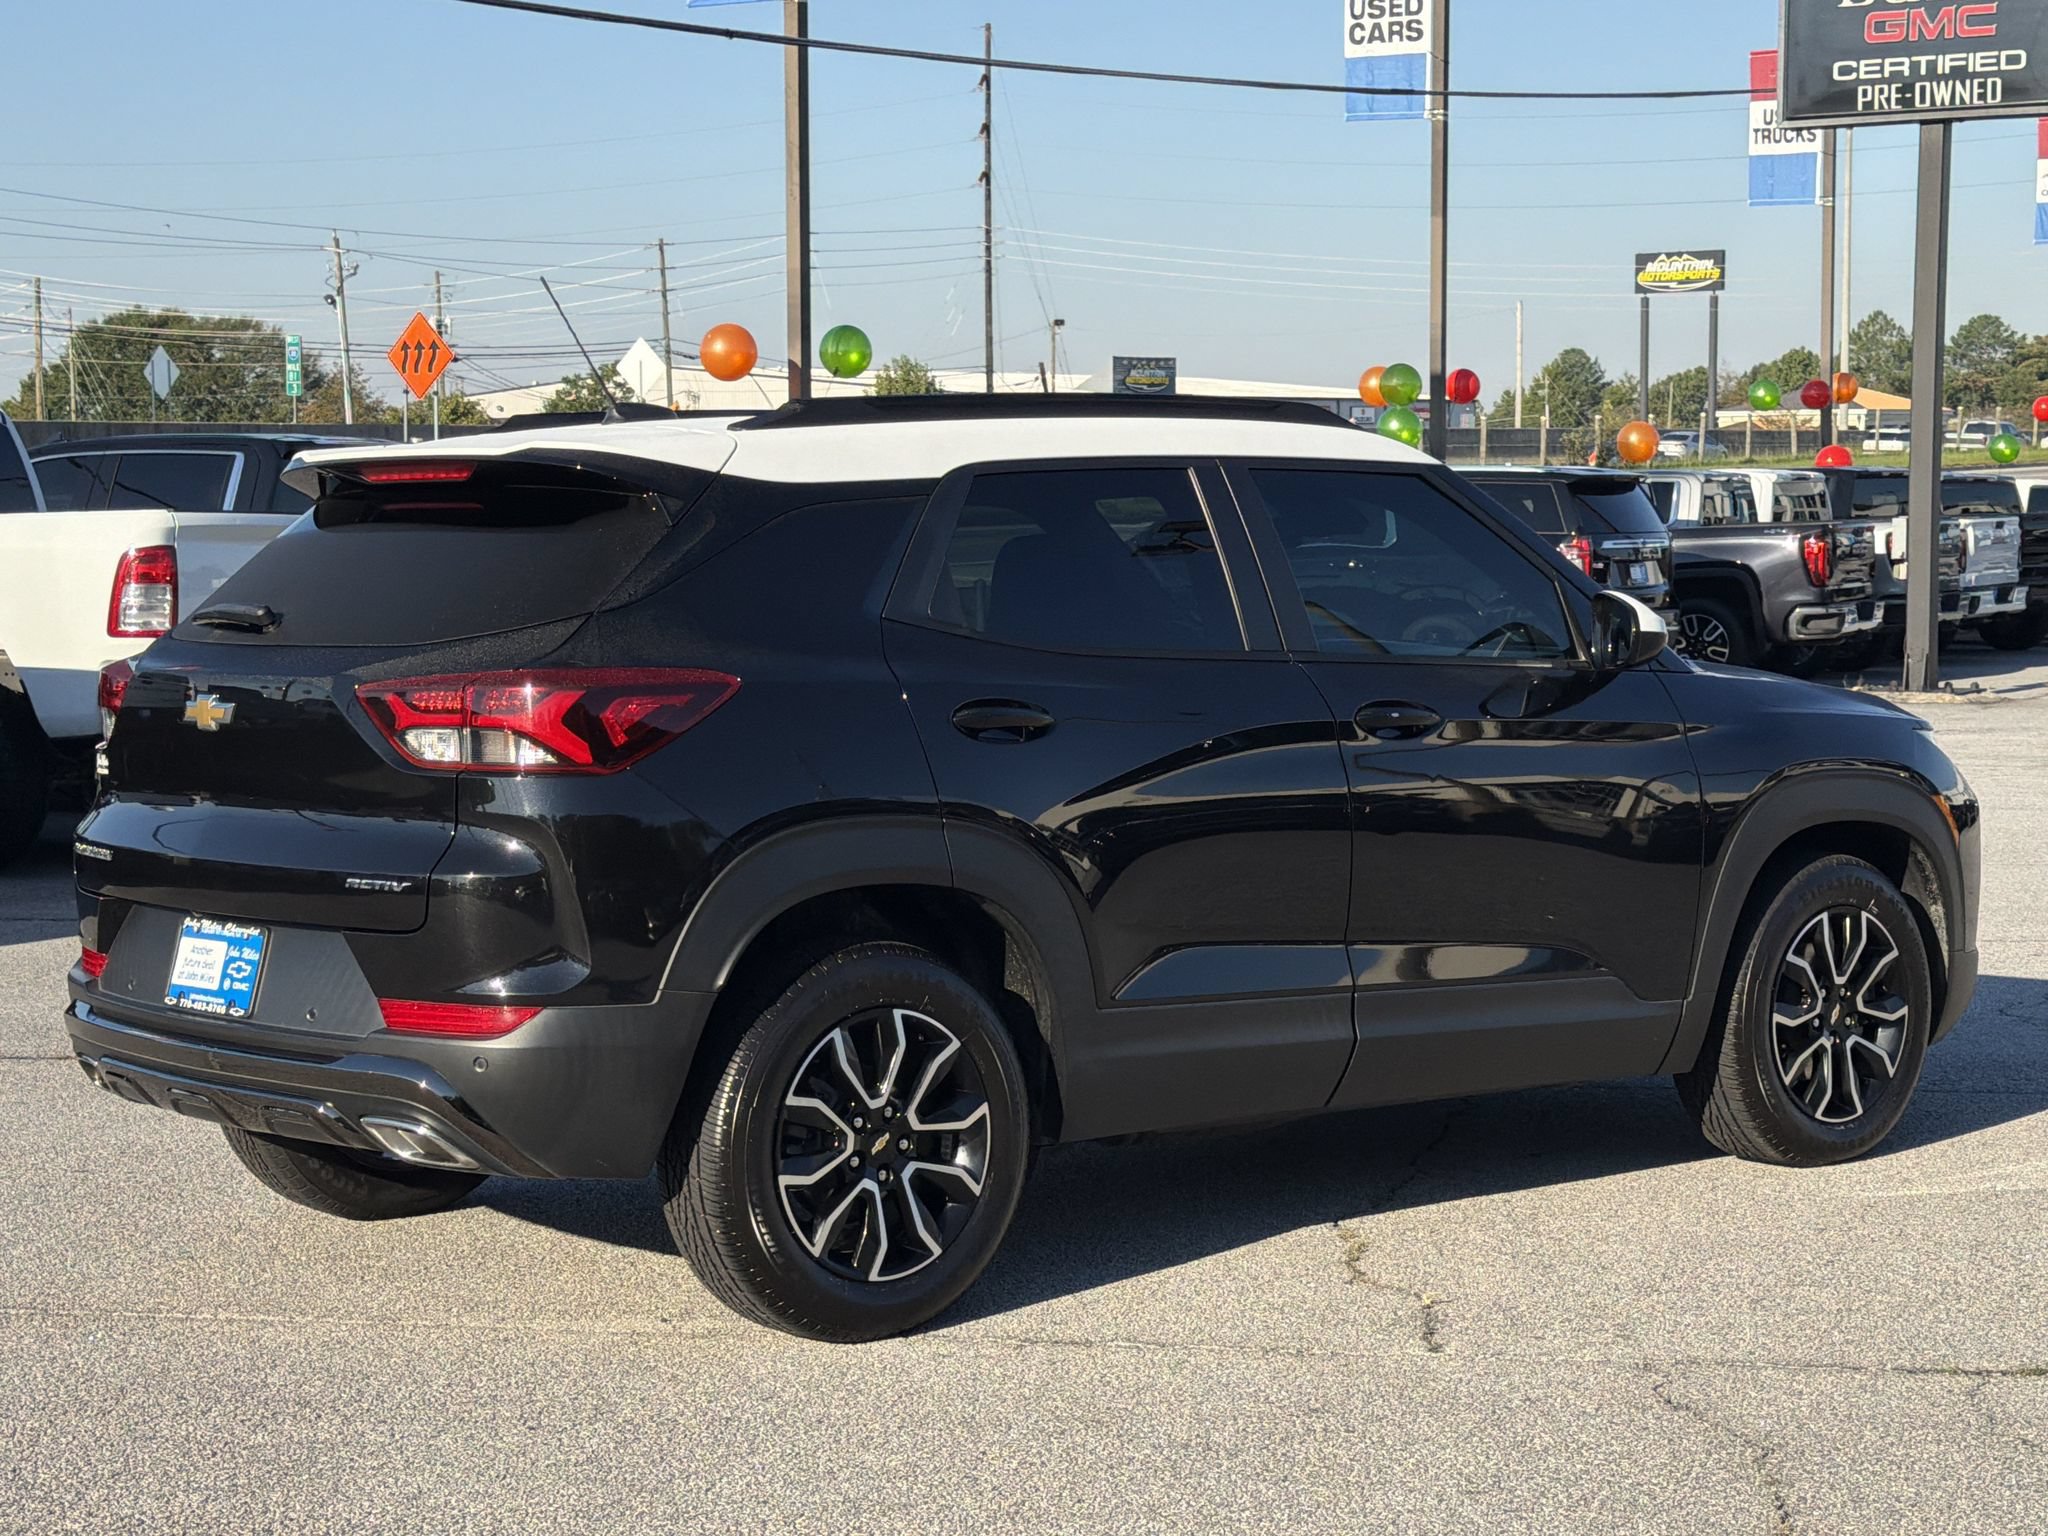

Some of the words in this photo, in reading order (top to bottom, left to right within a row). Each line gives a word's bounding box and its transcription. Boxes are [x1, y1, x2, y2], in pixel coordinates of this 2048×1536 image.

[1350, 0, 1423, 20] USED
[1349, 19, 1424, 45] CARS
[1864, 2, 1998, 44] GMC
[1832, 49, 2027, 81] CERTIFIED
[1857, 77, 2001, 111] PRE-OWNED
[1753, 127, 1817, 144] TRUCKS
[1640, 269, 1721, 282] MOTORSPORTS
[1645, 259, 1714, 273] MOUNTAIN
